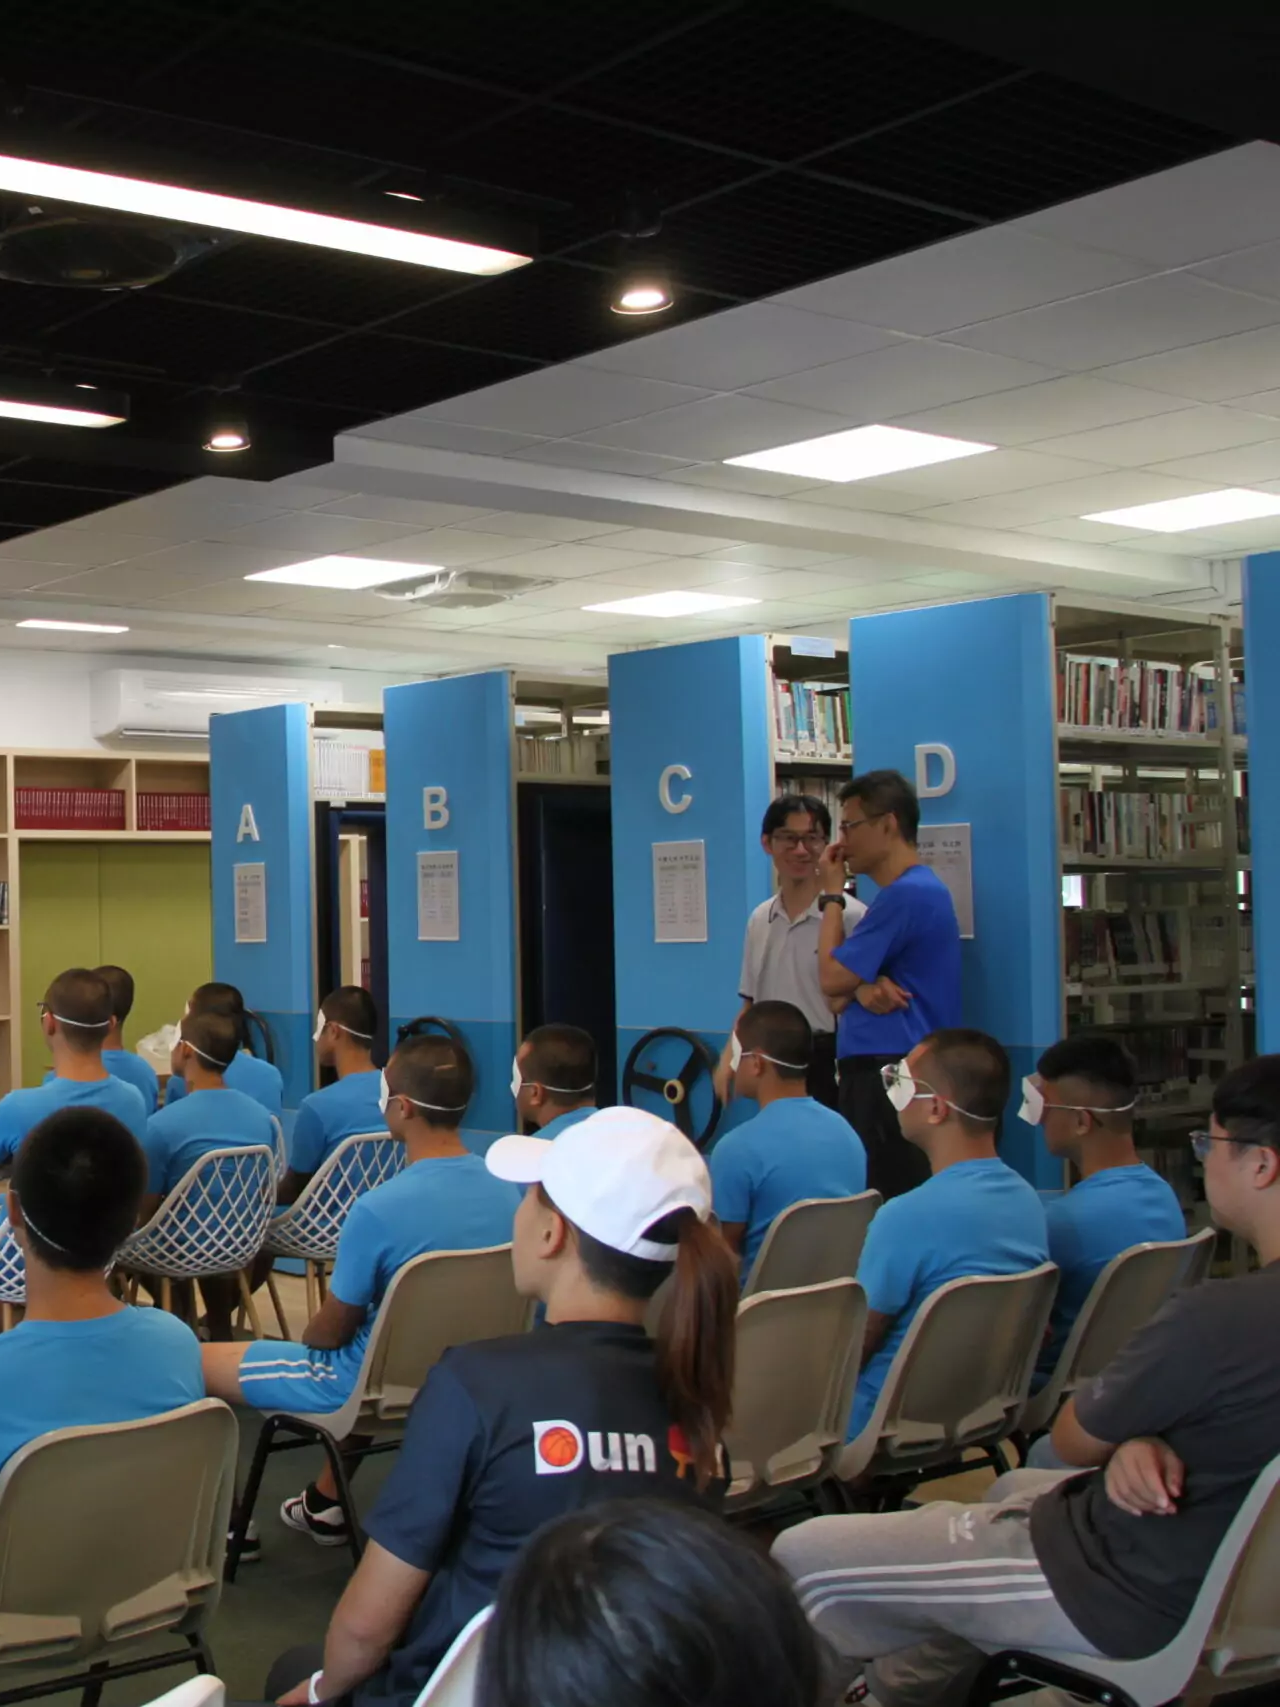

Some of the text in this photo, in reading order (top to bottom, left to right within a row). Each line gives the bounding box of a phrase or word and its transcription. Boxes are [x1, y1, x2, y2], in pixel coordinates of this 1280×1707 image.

[658, 764, 693, 814] C
[914, 743, 957, 799] D
[236, 804, 261, 843] A
[422, 786, 450, 830] B
[532, 1419, 657, 1475] Dun
